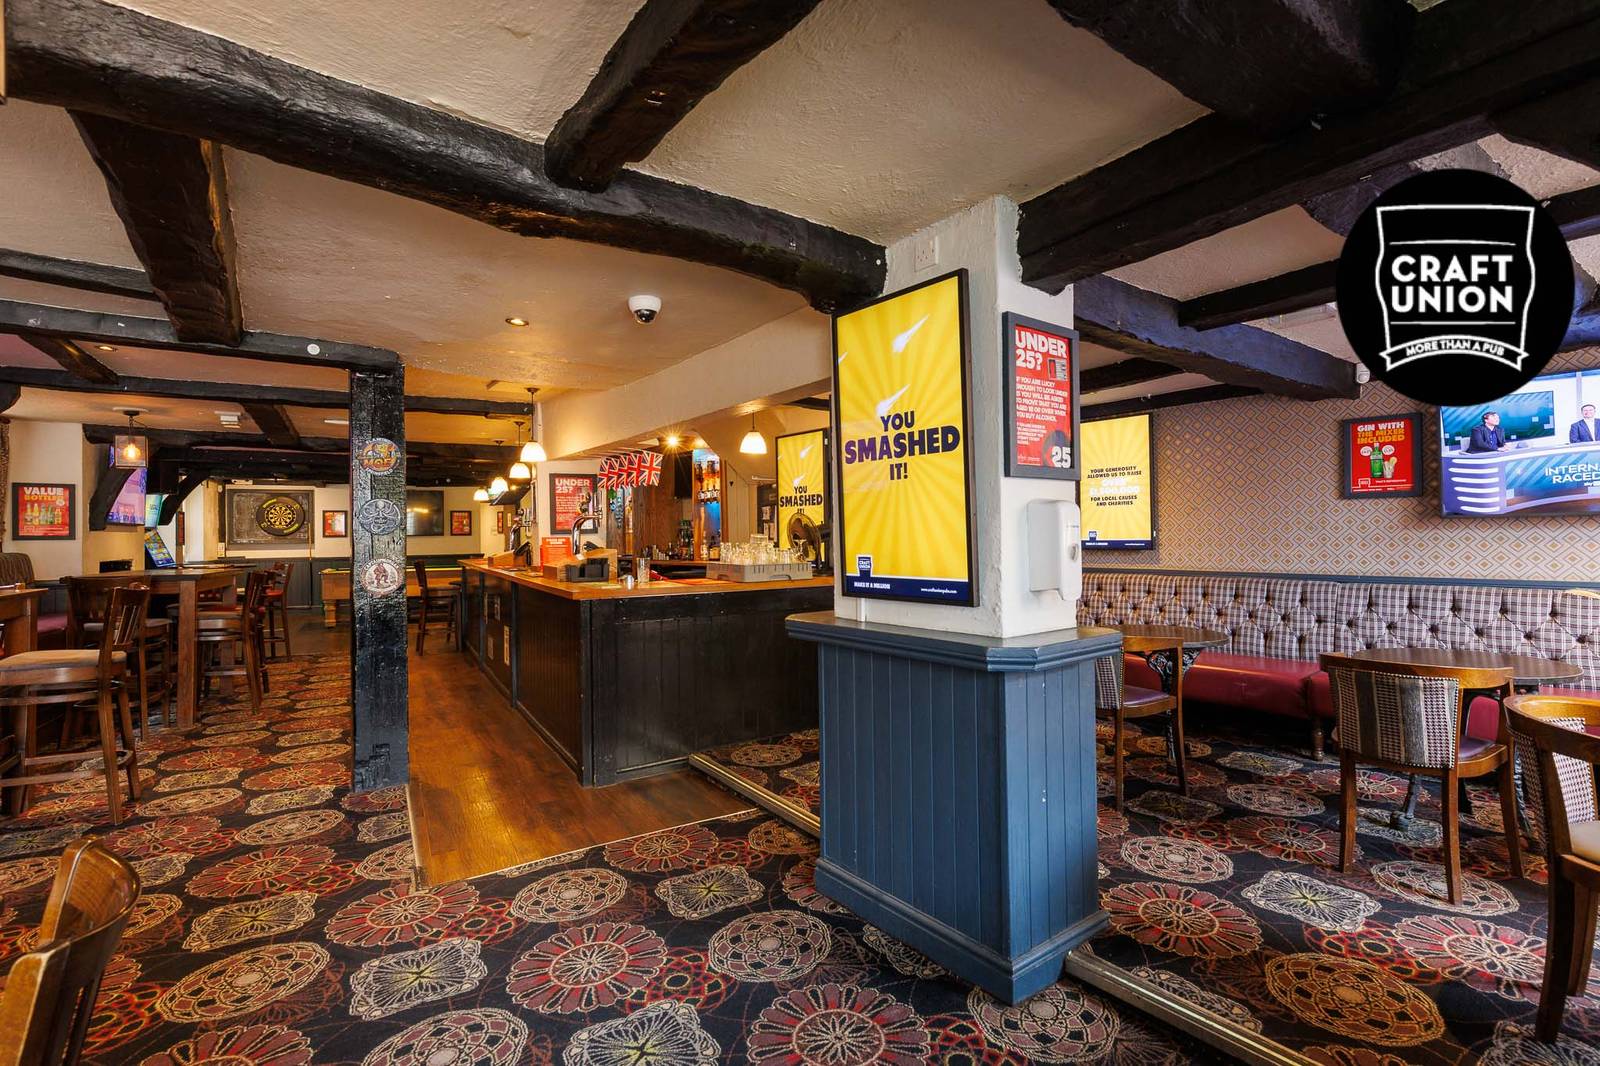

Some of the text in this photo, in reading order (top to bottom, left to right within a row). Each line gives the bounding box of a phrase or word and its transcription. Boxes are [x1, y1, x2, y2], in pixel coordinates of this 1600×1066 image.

[1015, 329, 1067, 358] UNDER
[1015, 349, 1043, 371] 25?
[880, 410, 915, 432] YOU
[1357, 421, 1405, 432] GIN WITH
[1376, 428, 1405, 436] MIXER
[844, 425, 961, 465] SMASHED
[1357, 434, 1406, 444] INCLUDED
[1051, 446, 1071, 469] 25
[889, 462, 909, 480] IT!
[1105, 465, 1137, 473] GENEROSITY
[1545, 463, 1600, 476] INTERN
[555, 478, 590, 487] UNDER
[24, 487, 64, 496] VALUE
[555, 486, 574, 494] 25?
[794, 486, 808, 494] YOU
[780, 494, 823, 507] SMASHED
